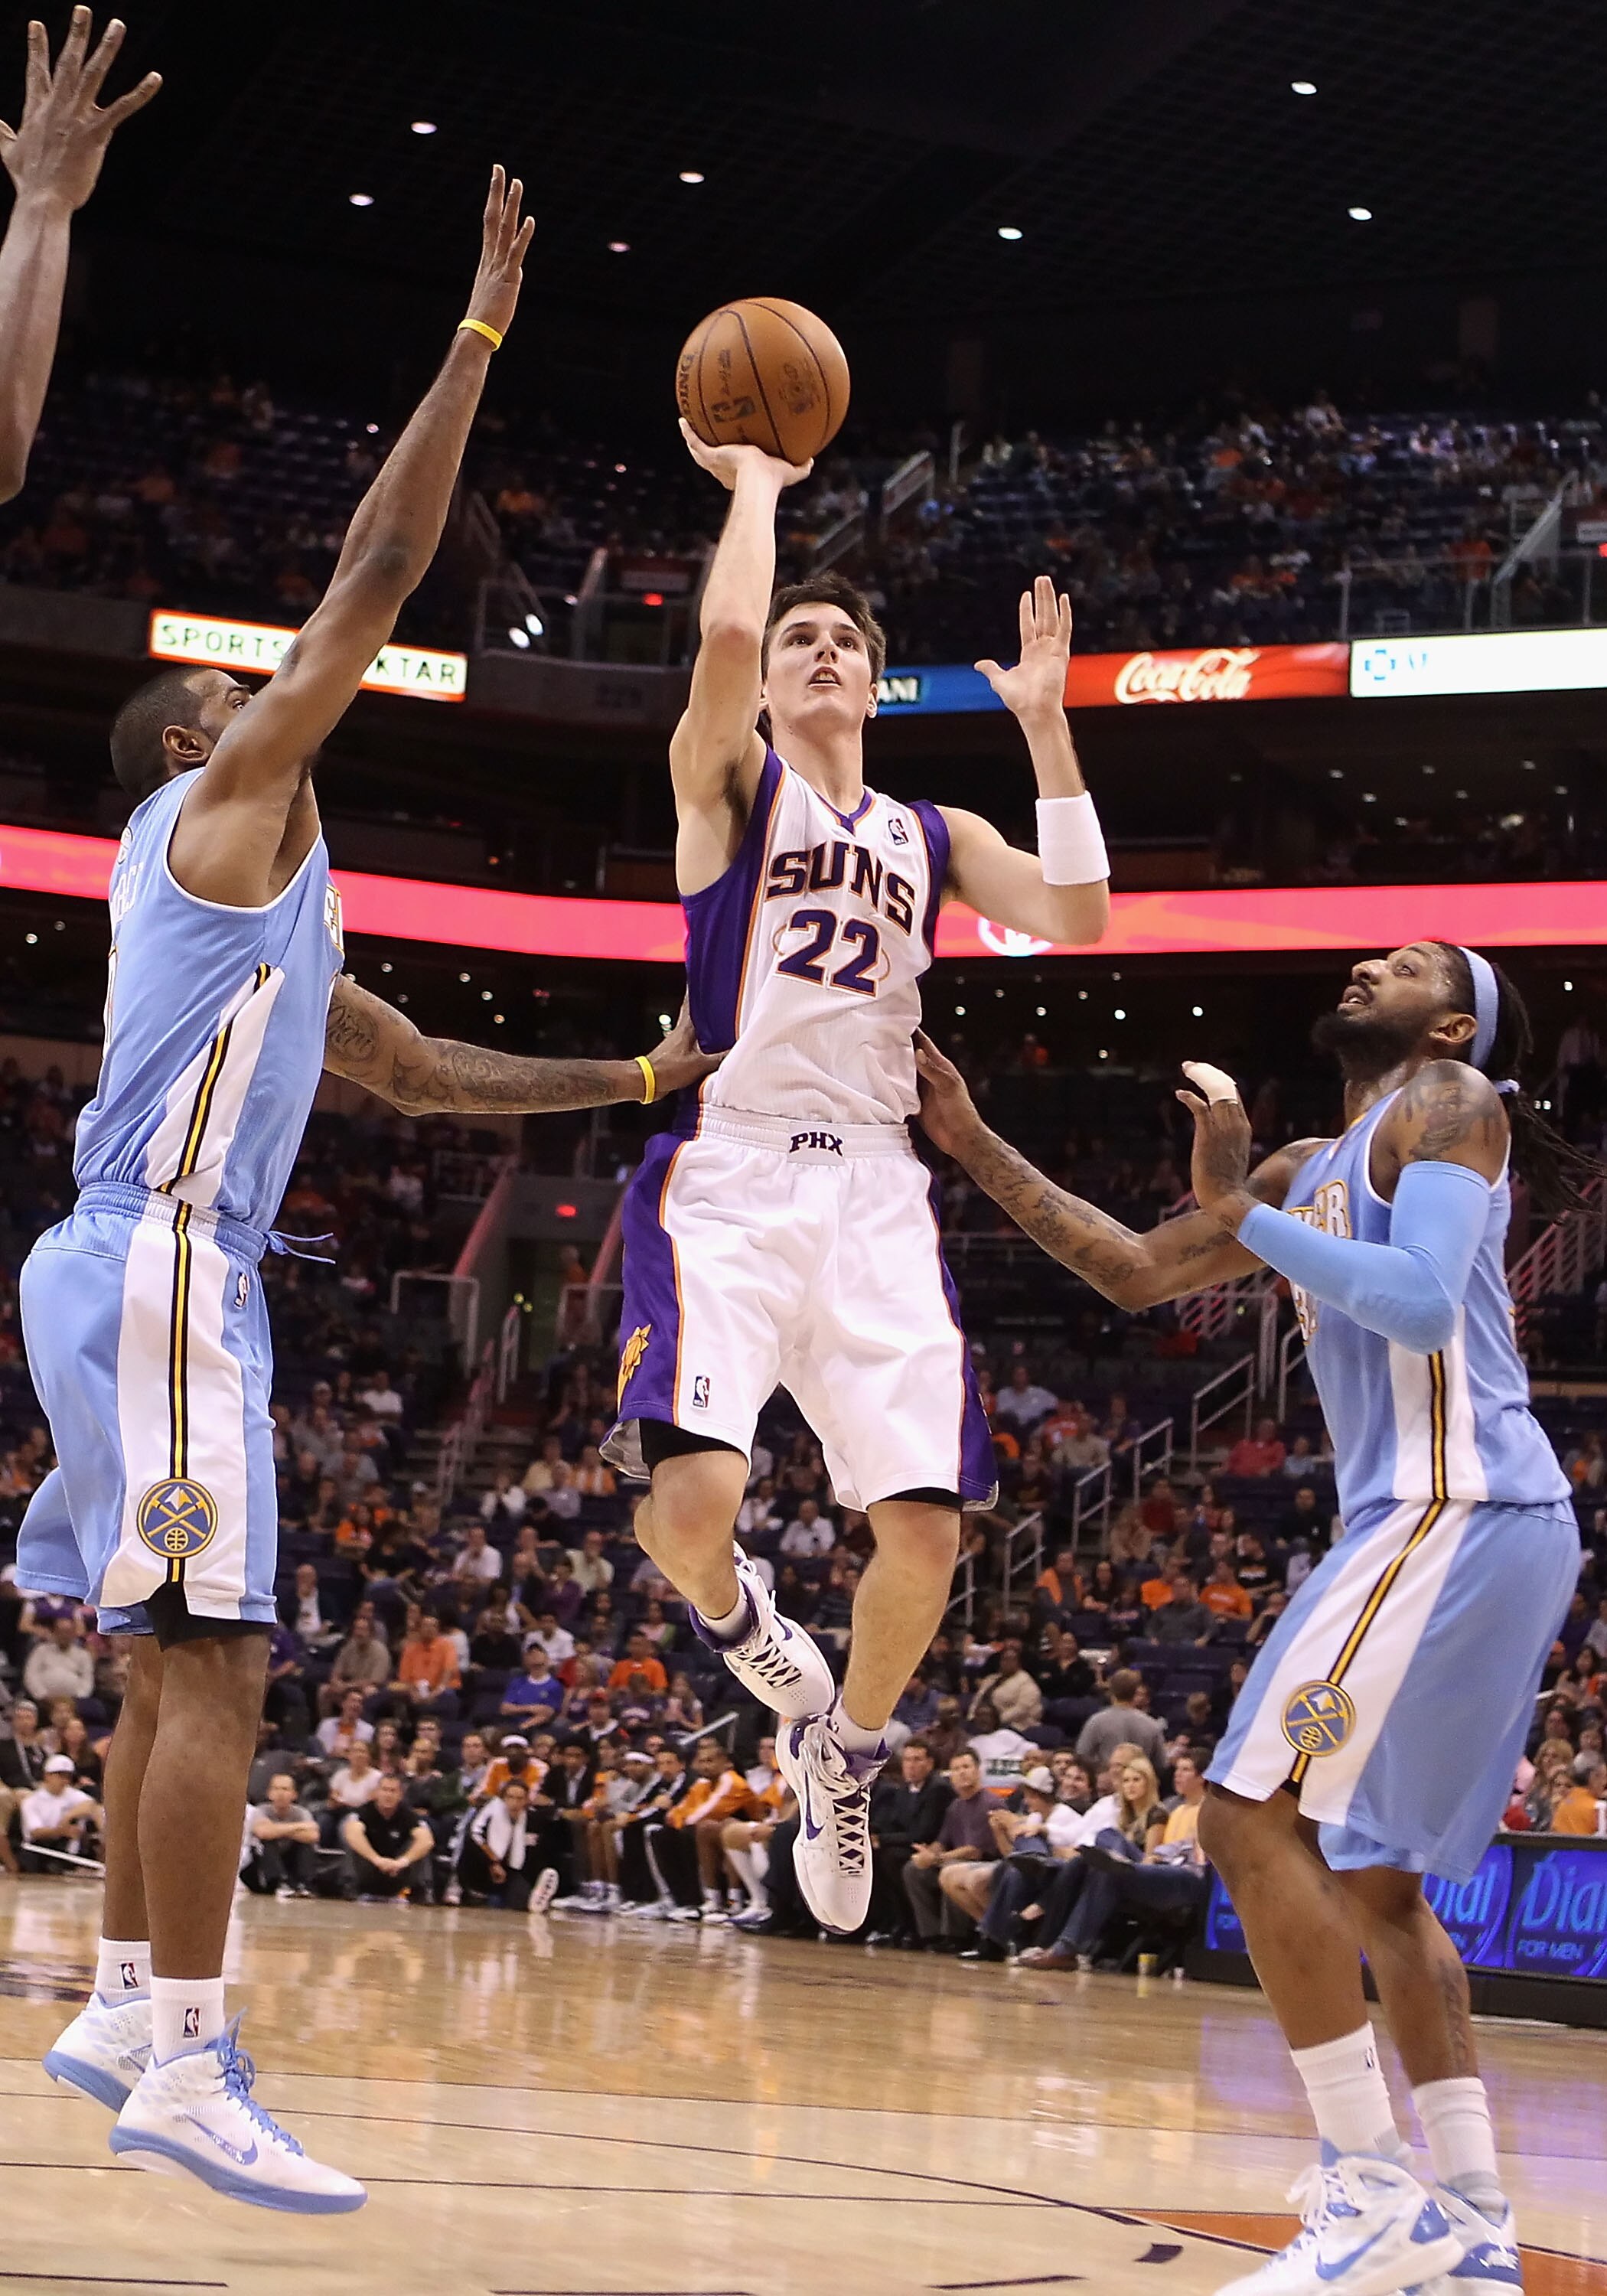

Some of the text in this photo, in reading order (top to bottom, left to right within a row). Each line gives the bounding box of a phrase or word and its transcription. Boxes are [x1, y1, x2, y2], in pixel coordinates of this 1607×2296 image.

[1114, 647, 1262, 705] Coca-Cola
[765, 840, 917, 937] SUNS
[775, 908, 882, 997] 22
[789, 1131, 843, 1157] PHX
